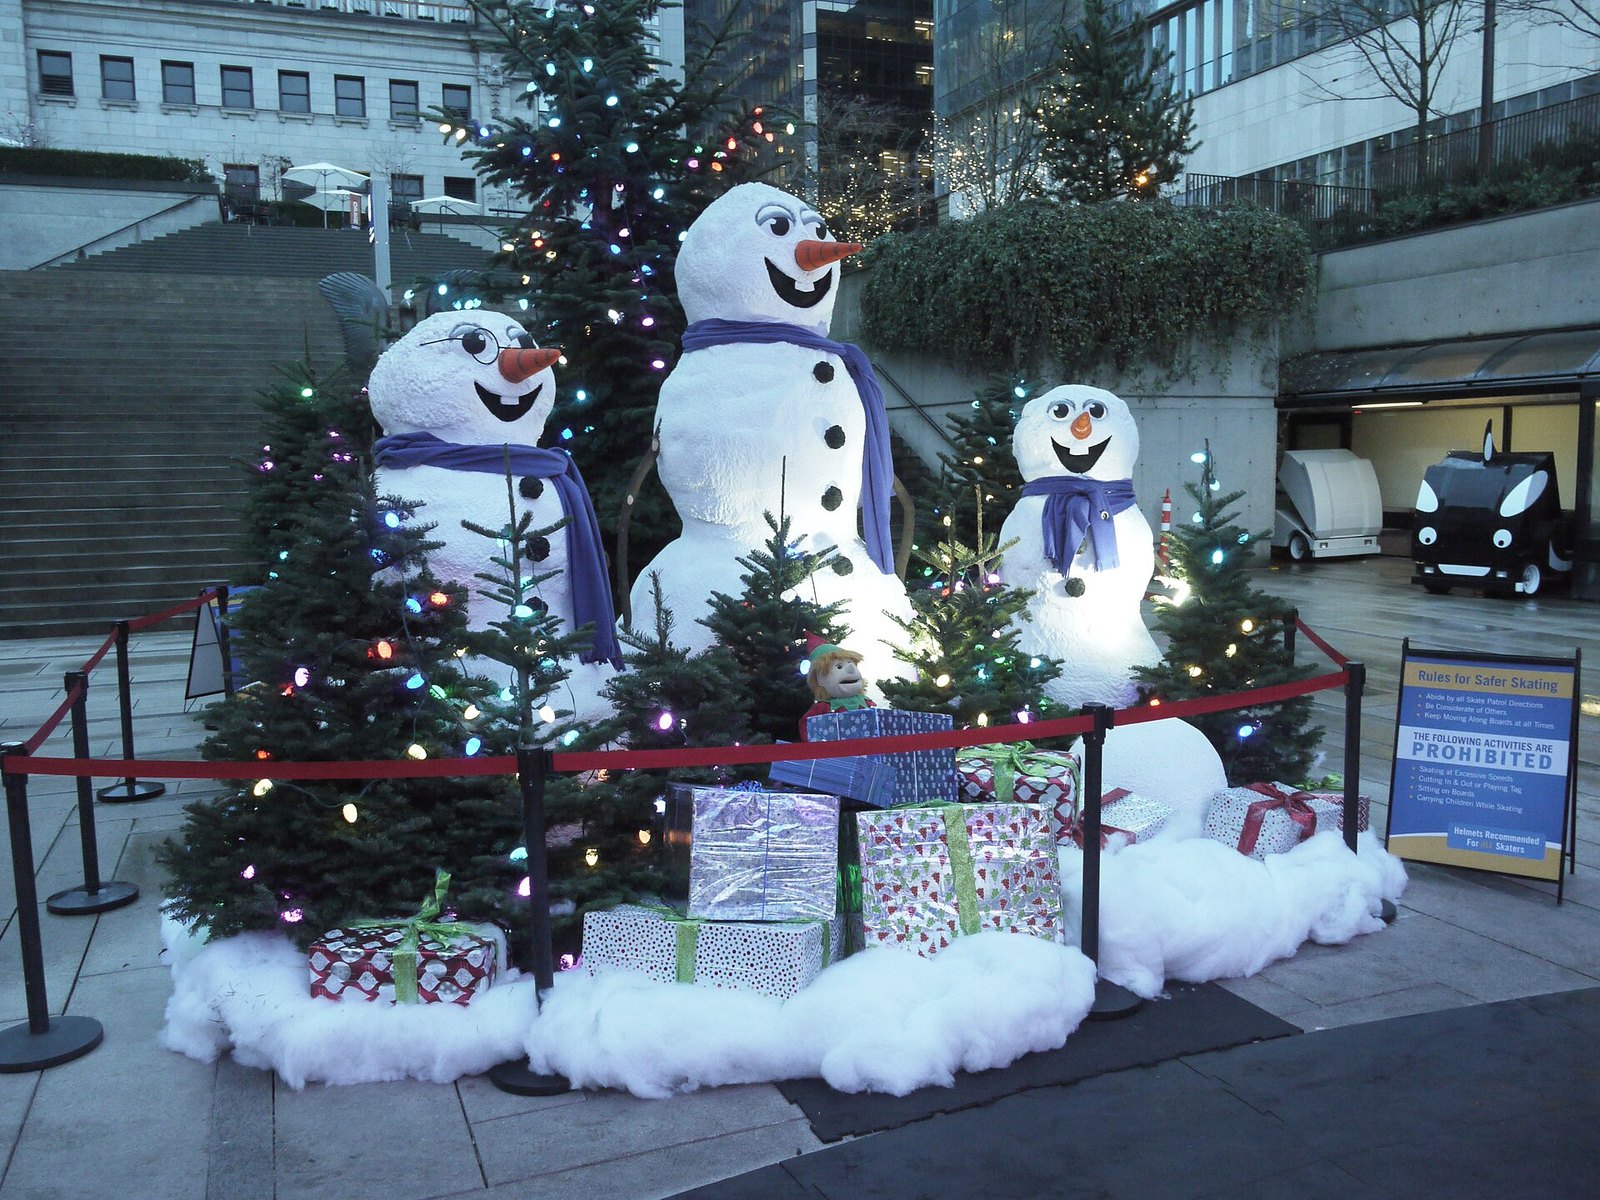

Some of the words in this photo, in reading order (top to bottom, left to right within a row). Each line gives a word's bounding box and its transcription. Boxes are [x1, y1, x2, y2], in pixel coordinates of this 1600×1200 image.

[1418, 670, 1451, 682] Rules
[1454, 673, 1472, 684] for
[1475, 674, 1507, 687] Safer
[1511, 677, 1558, 694] Skating
[1436, 704, 1475, 713] Considerate
[1484, 707, 1508, 716] Others
[1446, 695, 1454, 703] by
[1466, 696, 1486, 704] Skate
[1488, 698, 1507, 706] Patrol
[1508, 700, 1544, 709] Directions
[1424, 712, 1442, 720] Keep
[1443, 714, 1467, 724] Moving
[1468, 716, 1488, 725] Along
[1490, 718, 1514, 726] Boards
[1534, 722, 1554, 730] Times
[1414, 732, 1430, 742] THE
[1432, 734, 1482, 746] FOLLOWING
[1484, 739, 1532, 752] ACTIVITIES
[1536, 744, 1553, 754] ARE
[1412, 742, 1552, 770] PROHIBITED
[1420, 766, 1444, 776] Skating
[1454, 770, 1486, 780] Excessive
[1488, 773, 1513, 782] Speeds
[1418, 775, 1444, 785] Cutting
[1484, 782, 1508, 792] Playing
[1510, 786, 1522, 794] Tag
[1418, 784, 1440, 794] Sitting
[1452, 788, 1475, 798] Boards
[1416, 794, 1444, 804] Carrying
[1446, 798, 1474, 807] Children
[1476, 802, 1495, 810] While
[1496, 804, 1523, 814] Skating
[1454, 826, 1484, 838] Helmets
[1484, 831, 1540, 845] Recommended
[1466, 838, 1479, 847] For
[1496, 842, 1524, 854] Skaters
